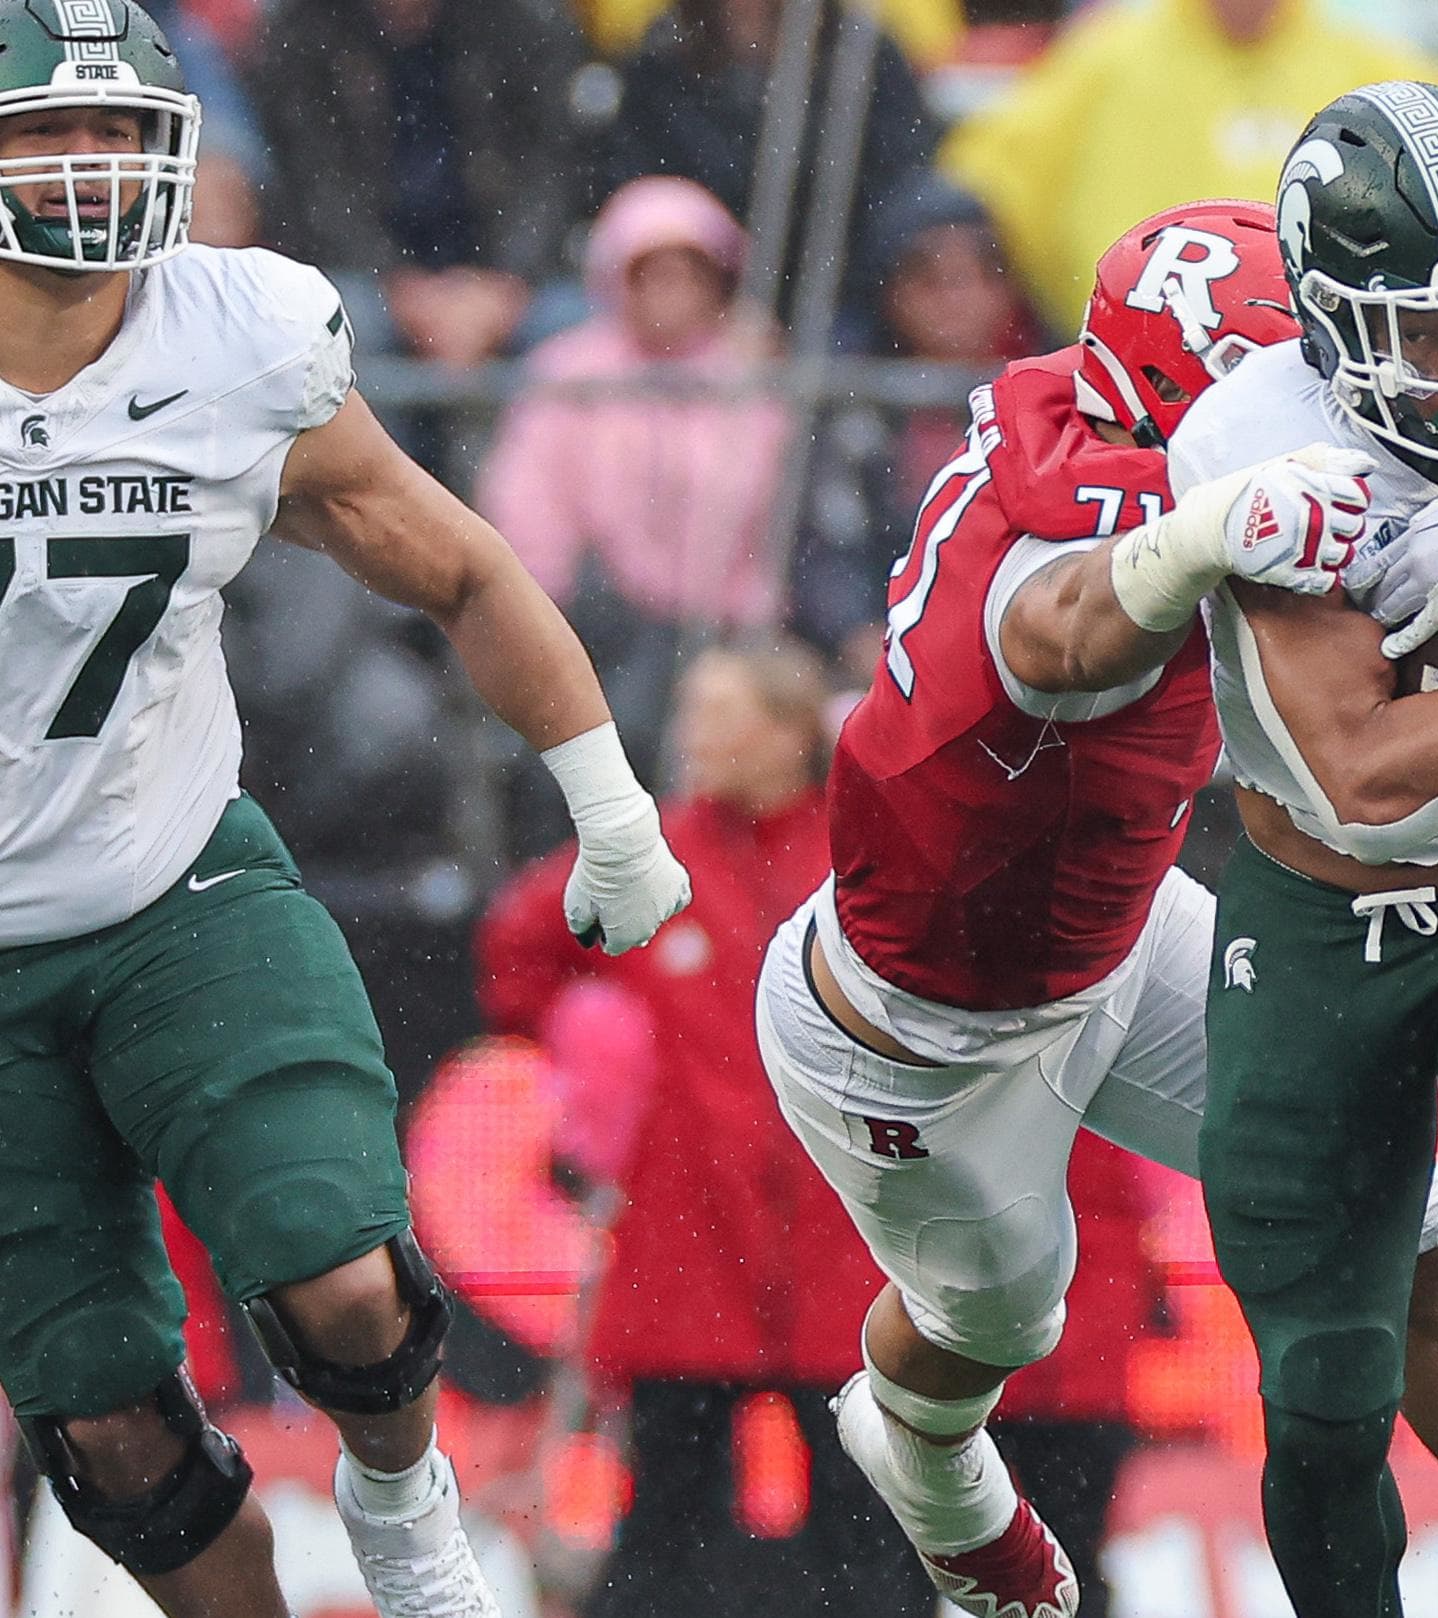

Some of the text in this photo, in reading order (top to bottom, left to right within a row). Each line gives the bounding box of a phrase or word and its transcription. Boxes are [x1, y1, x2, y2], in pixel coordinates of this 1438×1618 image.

[75, 64, 120, 80] STATE
[1125, 225, 1241, 330] R
[79, 475, 195, 514] STATE
[1076, 484, 1174, 538] 71
[1242, 487, 1265, 550] adidas
[863, 1116, 930, 1159] R
